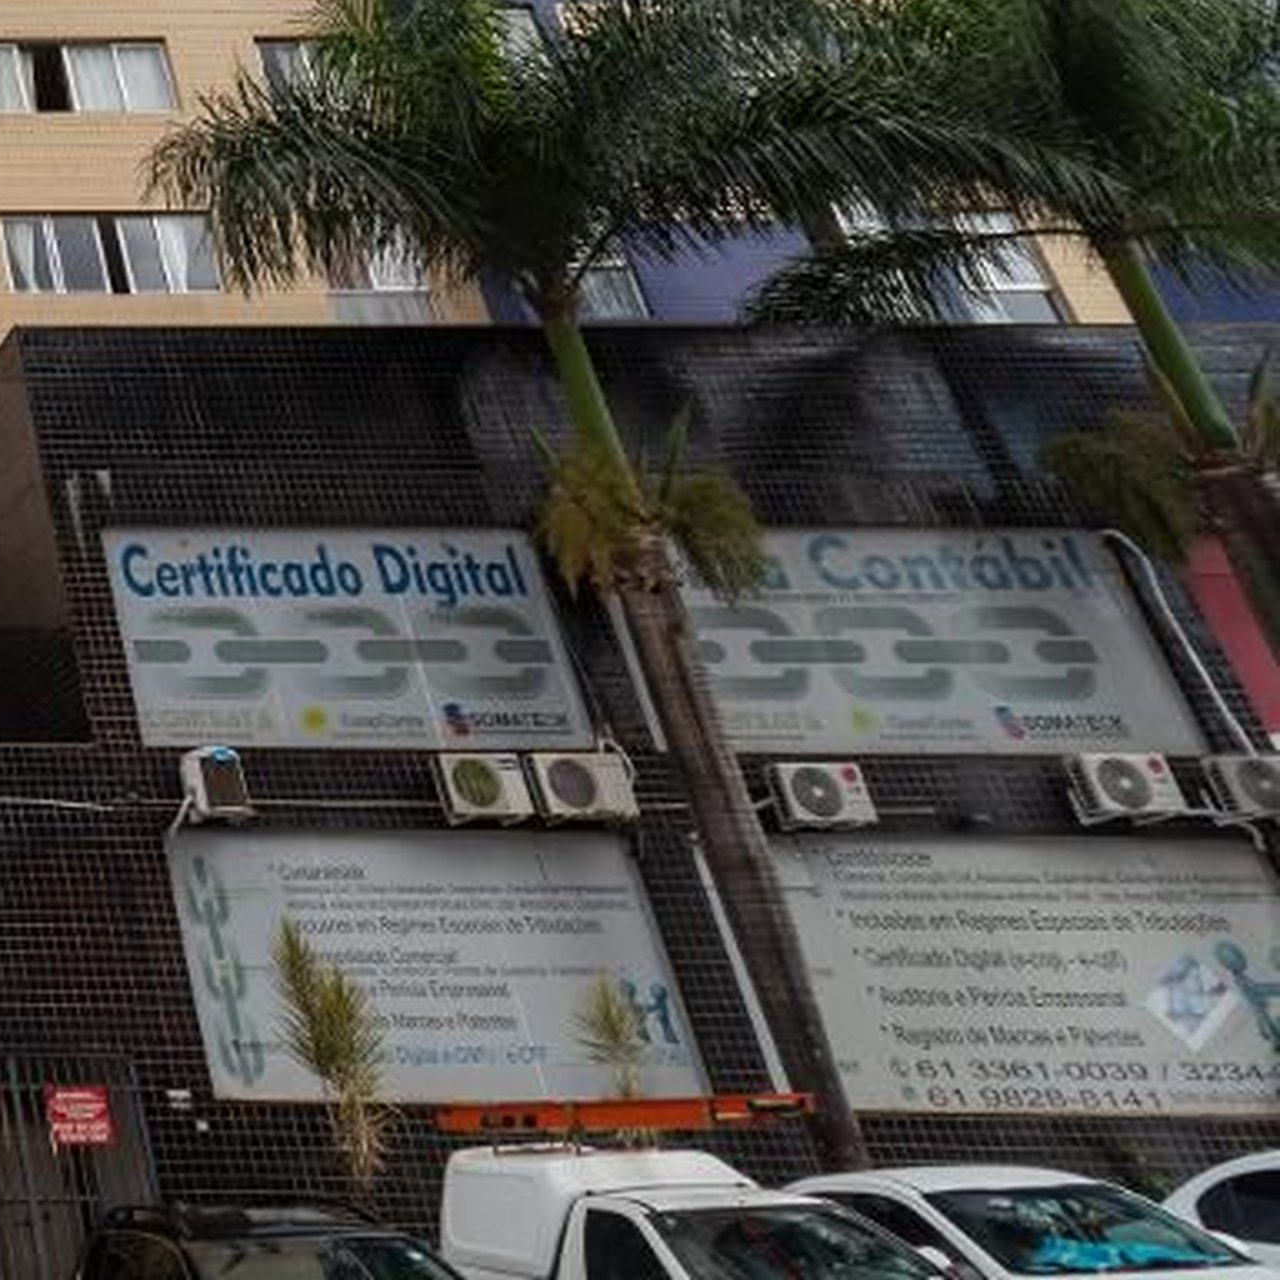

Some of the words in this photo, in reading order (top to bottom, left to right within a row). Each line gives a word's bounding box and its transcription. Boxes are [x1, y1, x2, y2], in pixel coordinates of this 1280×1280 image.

[120, 542, 362, 598] Certificado
[372, 542, 528, 607] Digital
[806, 532, 1095, 591] Contábil
